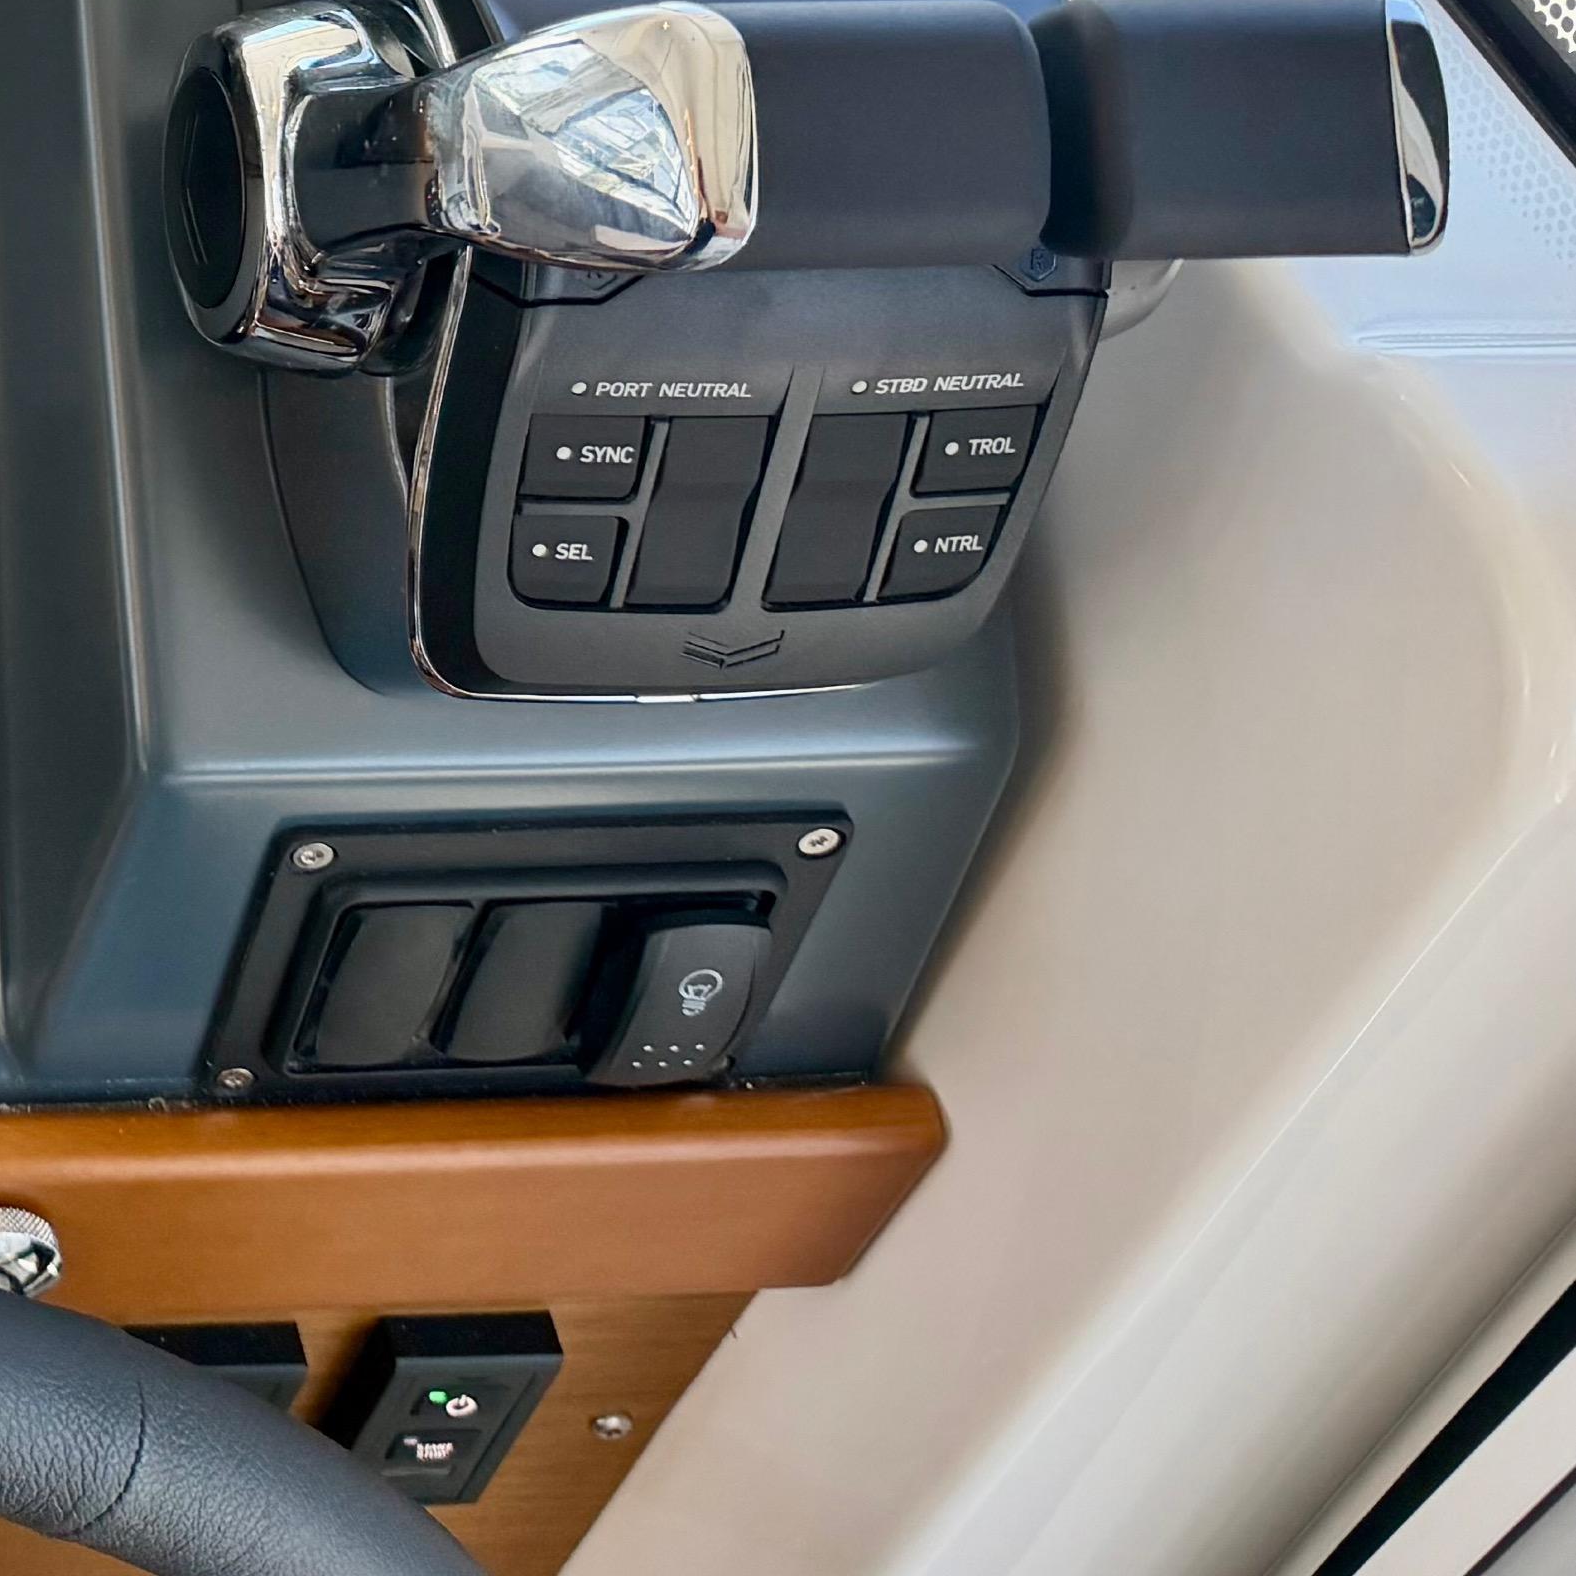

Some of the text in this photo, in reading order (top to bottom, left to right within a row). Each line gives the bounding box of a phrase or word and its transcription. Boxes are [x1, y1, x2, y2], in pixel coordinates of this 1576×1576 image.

[595, 381, 752, 398] PORT NEUTRAL
[875, 373, 1024, 395] STBD NEUTRAL
[580, 446, 635, 464] SYNC
[968, 437, 1016, 455] TROL
[554, 543, 594, 561] SEL
[934, 535, 984, 554] NTRL
